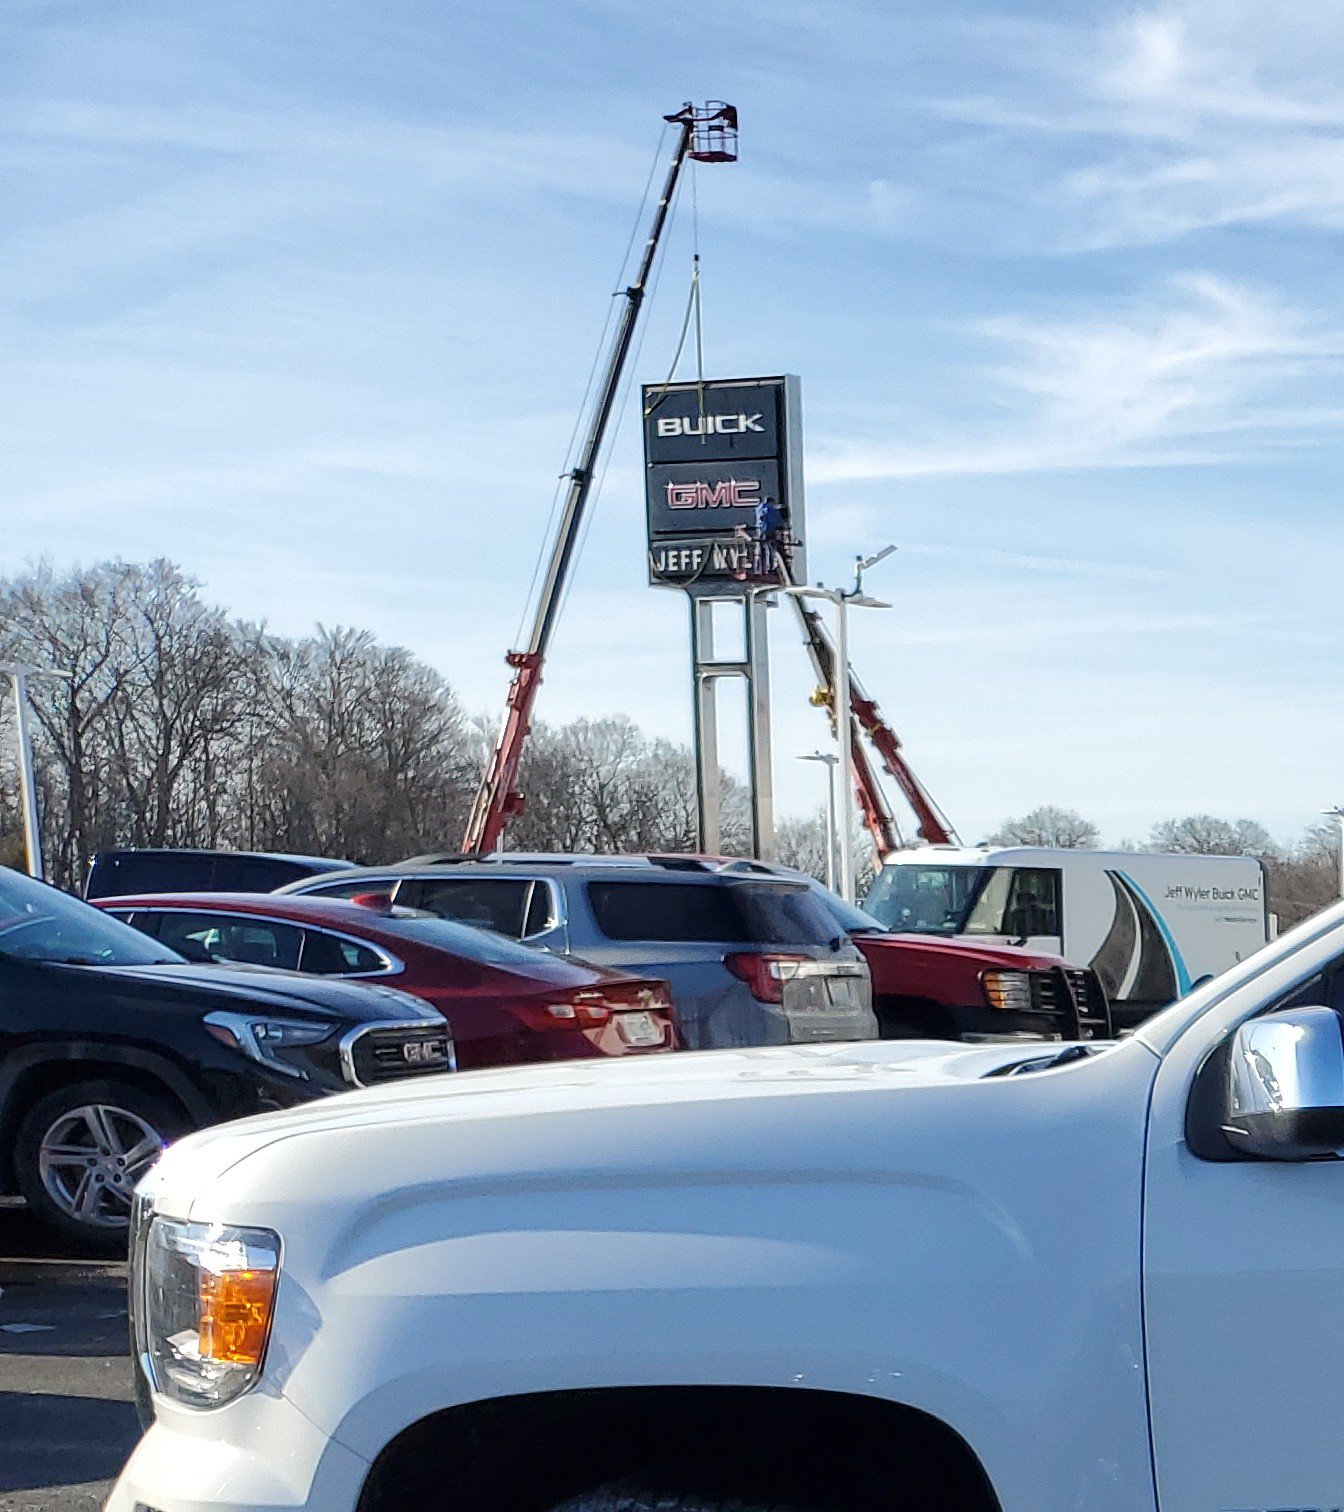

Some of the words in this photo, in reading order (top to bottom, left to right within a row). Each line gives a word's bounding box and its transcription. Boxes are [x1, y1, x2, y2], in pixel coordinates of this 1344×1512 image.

[657, 413, 765, 437] BUICK
[666, 480, 760, 510] GMC
[655, 549, 702, 571] JEFF
[1164, 886, 1184, 899] Jeff
[1184, 886, 1211, 902] Wyler
[1212, 887, 1236, 900] Buick
[1237, 887, 1260, 901] GMC
